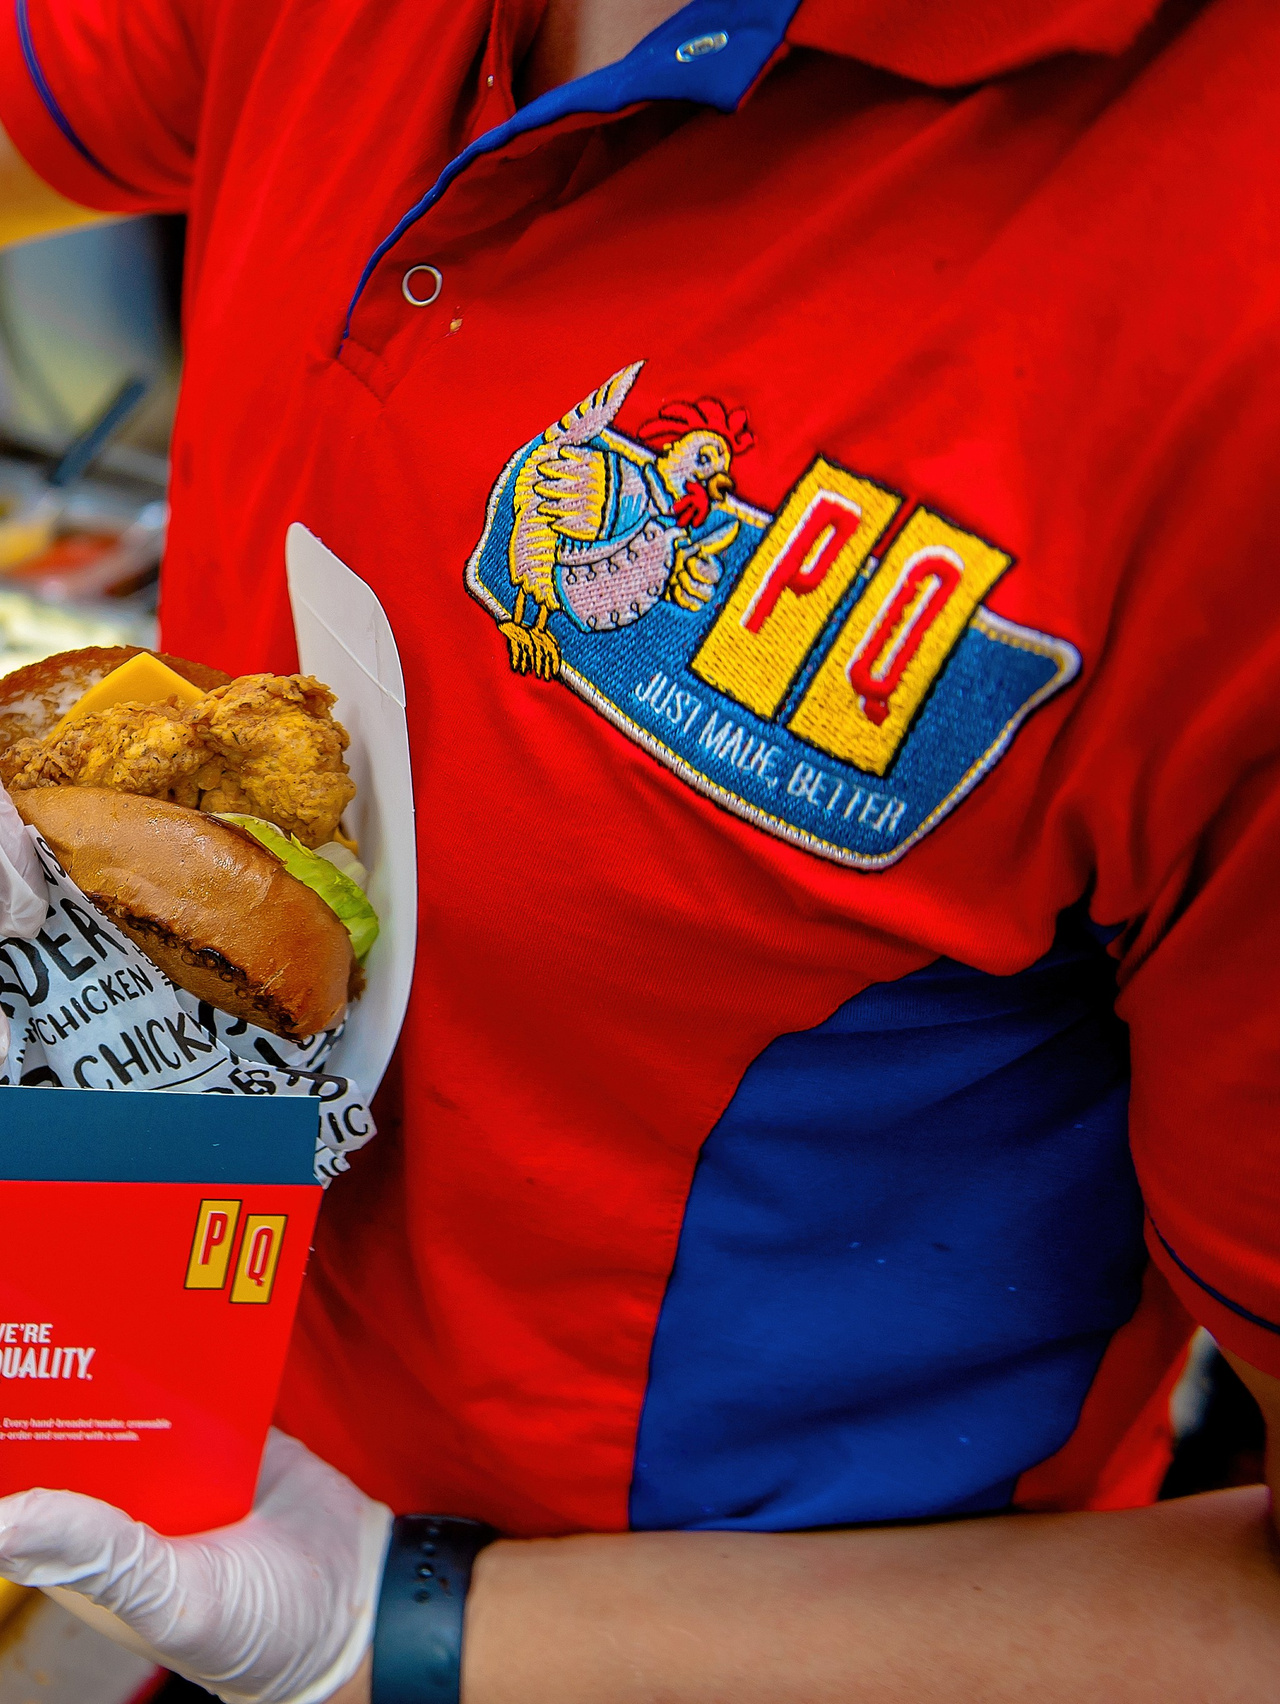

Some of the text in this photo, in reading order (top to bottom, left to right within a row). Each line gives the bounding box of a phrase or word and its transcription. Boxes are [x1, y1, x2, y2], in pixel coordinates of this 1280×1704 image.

[634, 670, 702, 734] JUST
[787, 760, 908, 834] BETTER
[35, 963, 155, 1046] CHICKEN
[3, 1417, 29, 1430] Every
[33, 1430, 53, 1441] and
[53, 1430, 84, 1441] served
